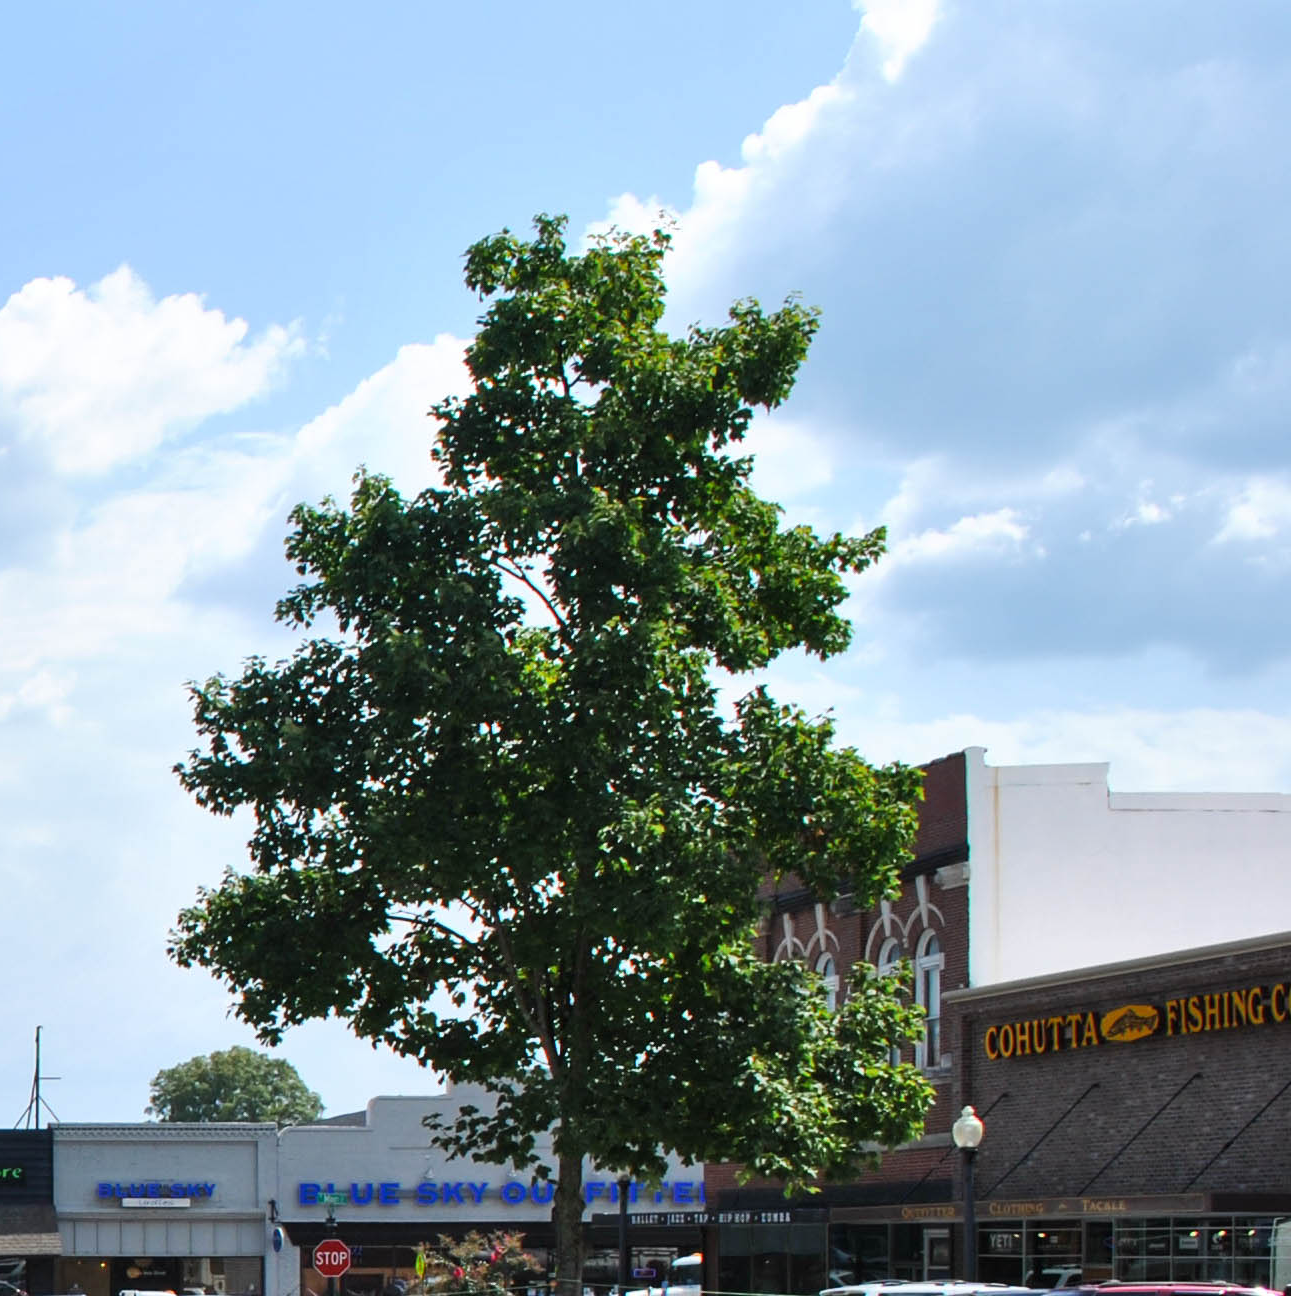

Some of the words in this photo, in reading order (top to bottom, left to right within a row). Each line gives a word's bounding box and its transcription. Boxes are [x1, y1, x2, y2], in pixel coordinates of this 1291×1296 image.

[984, 1011, 1100, 1061] COHUTTA
[1166, 986, 1265, 1037] FISHING
[1271, 983, 1291, 1022] C
[96, 1182, 160, 1199] BLUE
[170, 1182, 216, 1199] SKY
[416, 1181, 489, 1205] SKY
[988, 1201, 1044, 1216] CLOTHING
[631, 1214, 658, 1225] BALLET
[666, 1214, 685, 1226] JAZZ
[694, 1213, 709, 1224] TAP
[719, 1213, 733, 1223] HIP
[735, 1212, 751, 1223] HOP
[761, 1211, 791, 1223] ZUMBA
[989, 1232, 1012, 1249] YETI
[315, 1251, 349, 1266] STOP
